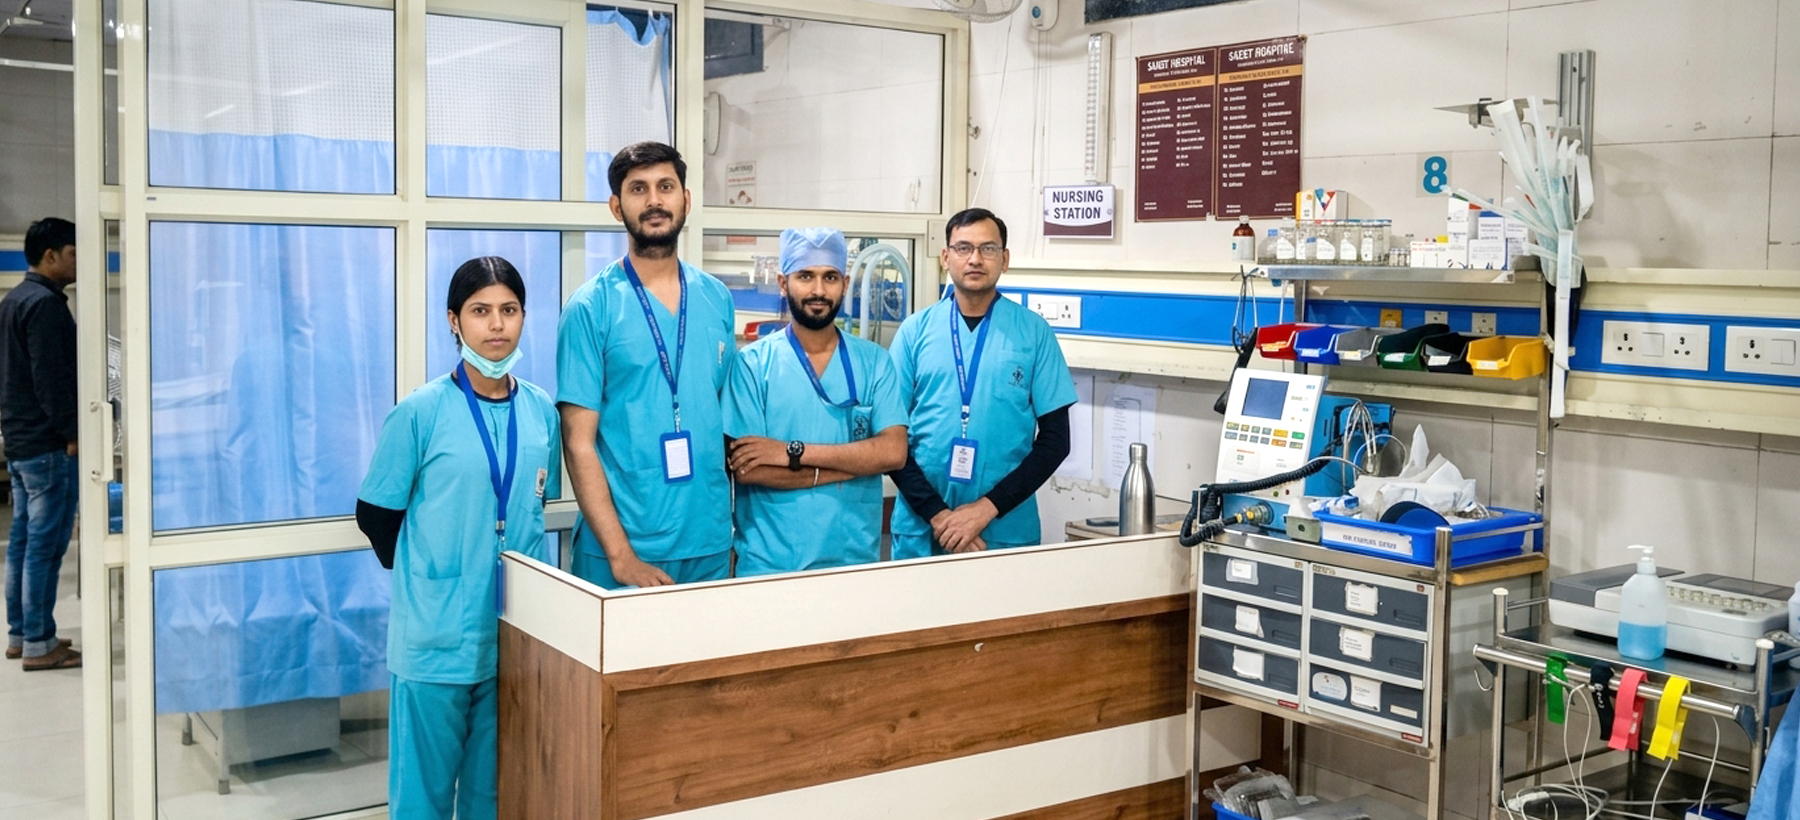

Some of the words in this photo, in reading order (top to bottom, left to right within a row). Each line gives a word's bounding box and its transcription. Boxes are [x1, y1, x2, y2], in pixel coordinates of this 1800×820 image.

[1423, 156, 1447, 194] 8
[1052, 190, 1104, 203] NURSING
[1053, 207, 1101, 219] STATION
